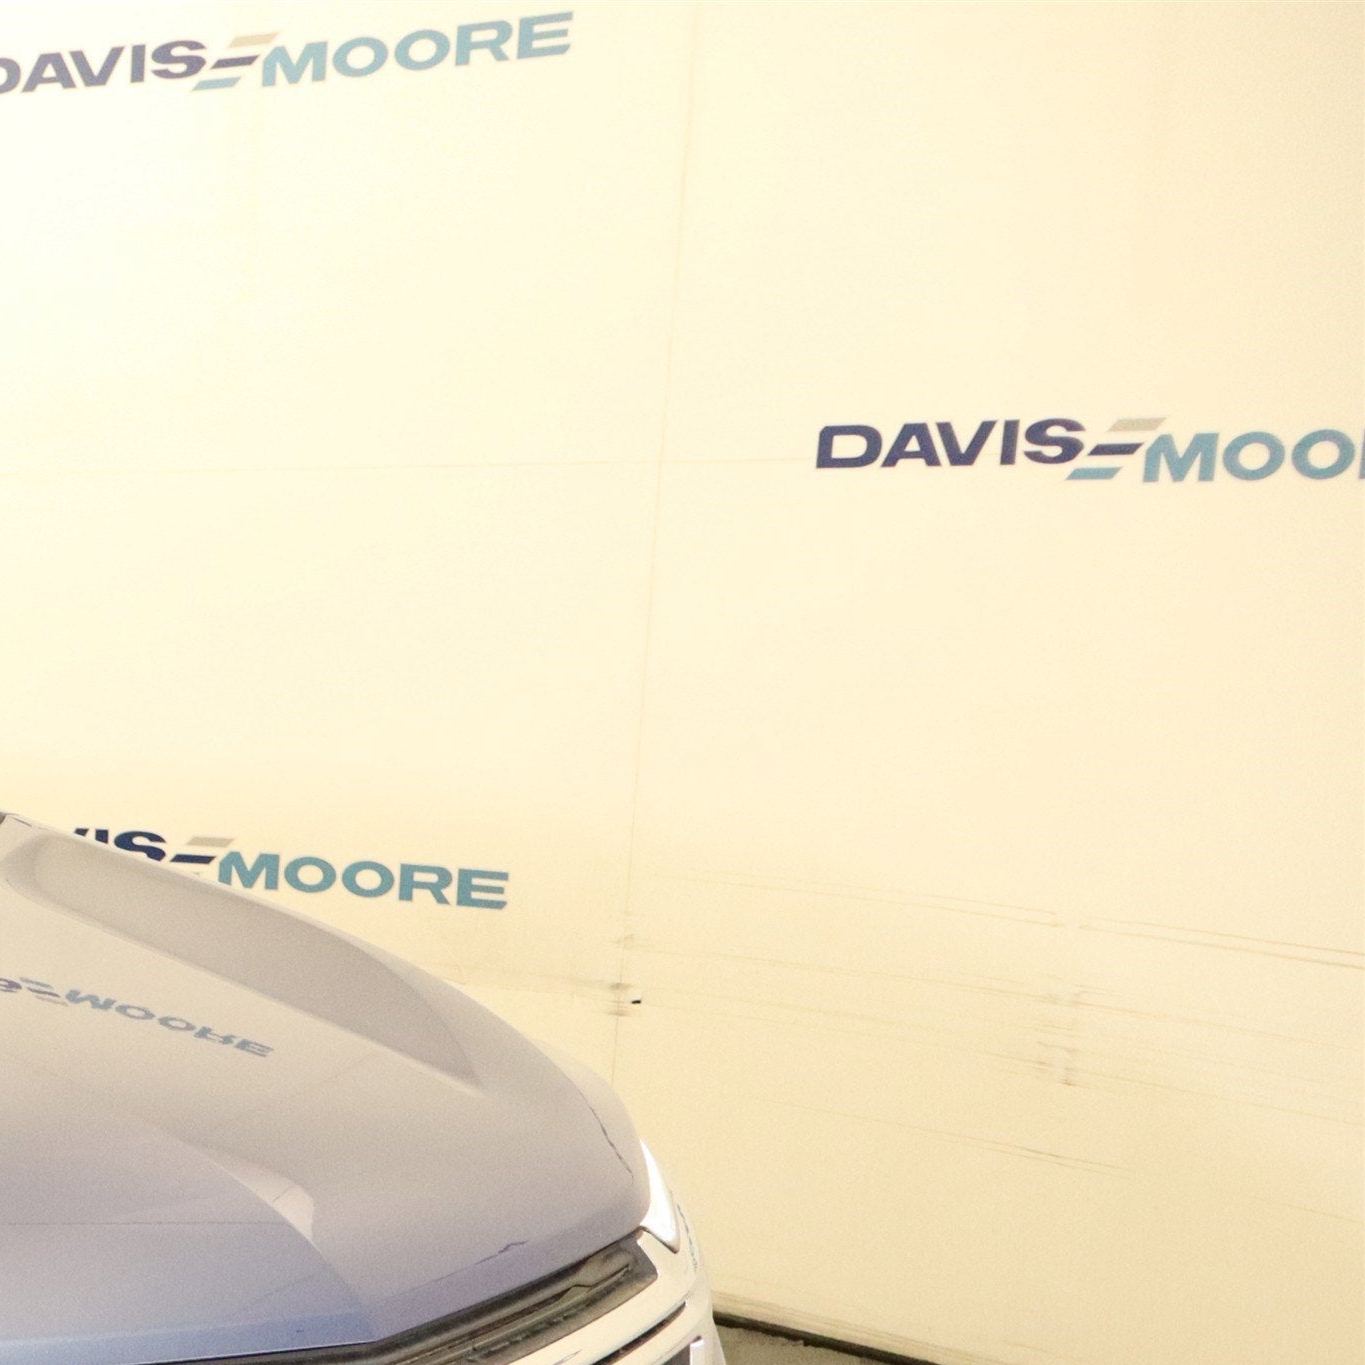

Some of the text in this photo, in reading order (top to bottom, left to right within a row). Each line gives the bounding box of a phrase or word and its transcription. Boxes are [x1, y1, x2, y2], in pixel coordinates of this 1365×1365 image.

[260, 11, 574, 88] MOORE
[815, 418, 1365, 483] DAVIS MOO
[218, 850, 509, 910] MOORE
